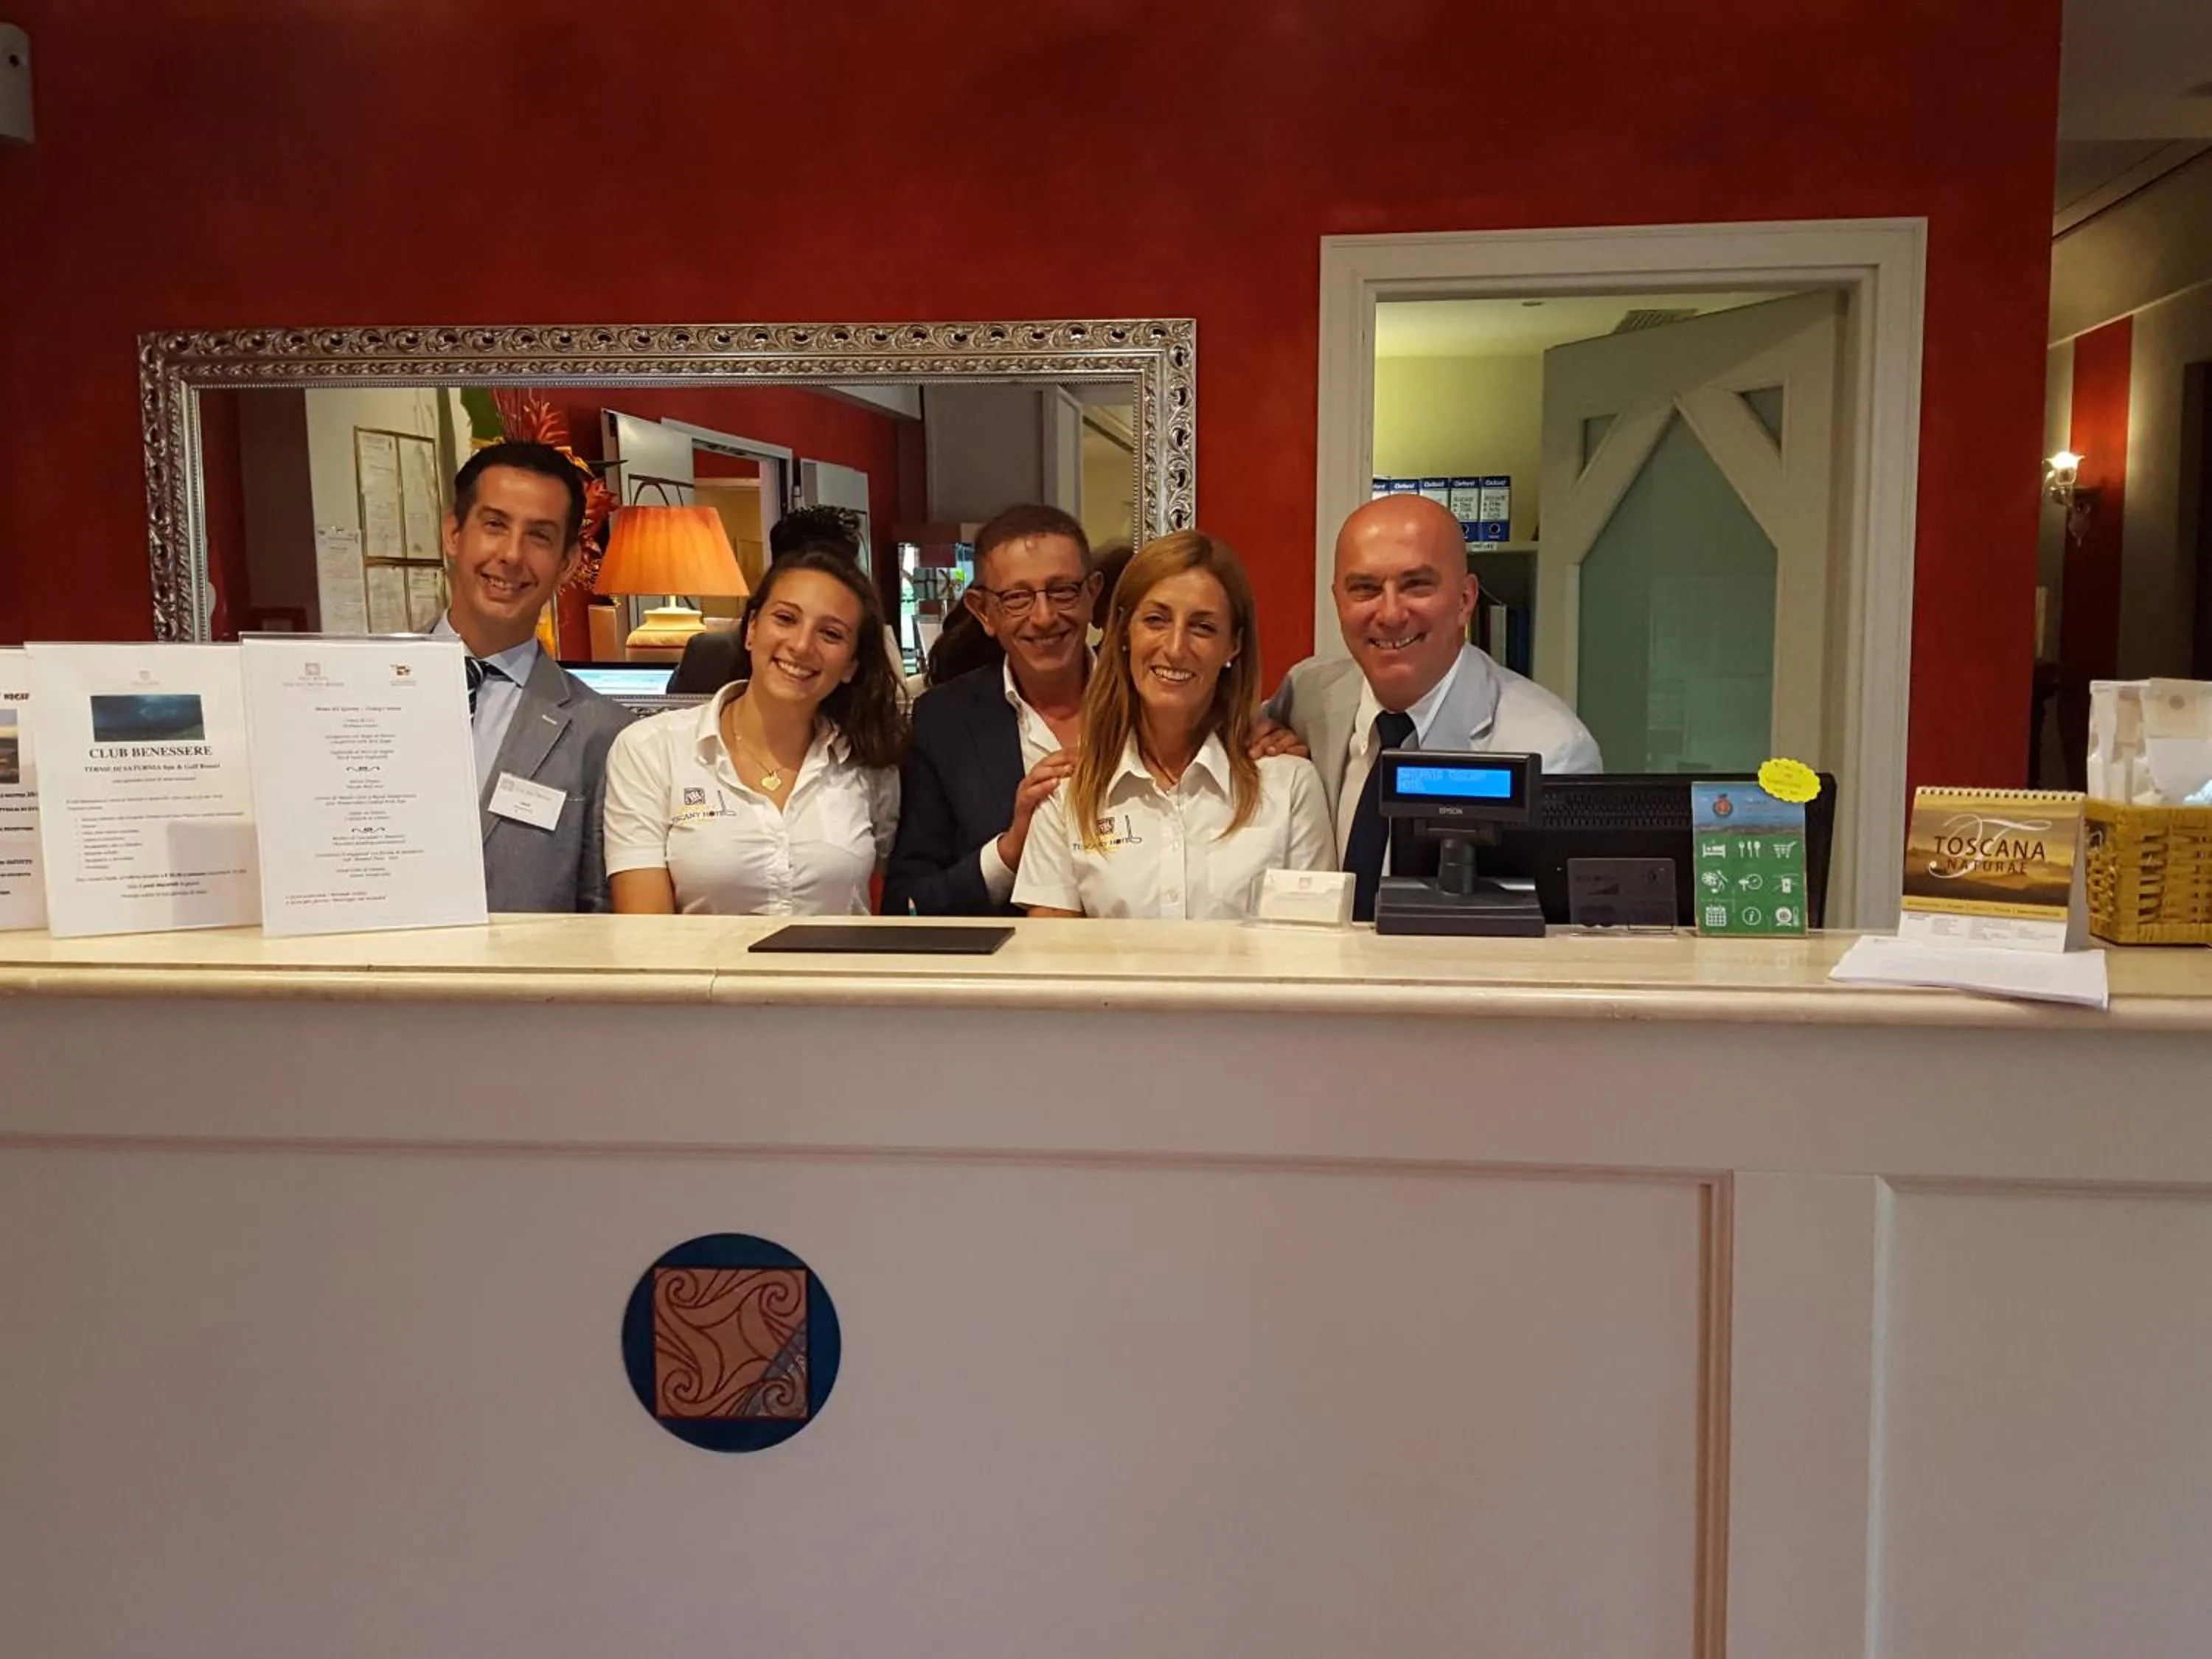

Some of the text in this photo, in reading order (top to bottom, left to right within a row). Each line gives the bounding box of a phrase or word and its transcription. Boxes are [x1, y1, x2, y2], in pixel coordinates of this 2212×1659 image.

[89, 745, 212, 758] CLUB BENESSERE
[1439, 807, 1464, 815] EPSON
[1934, 835, 2046, 860] TOSCANA
